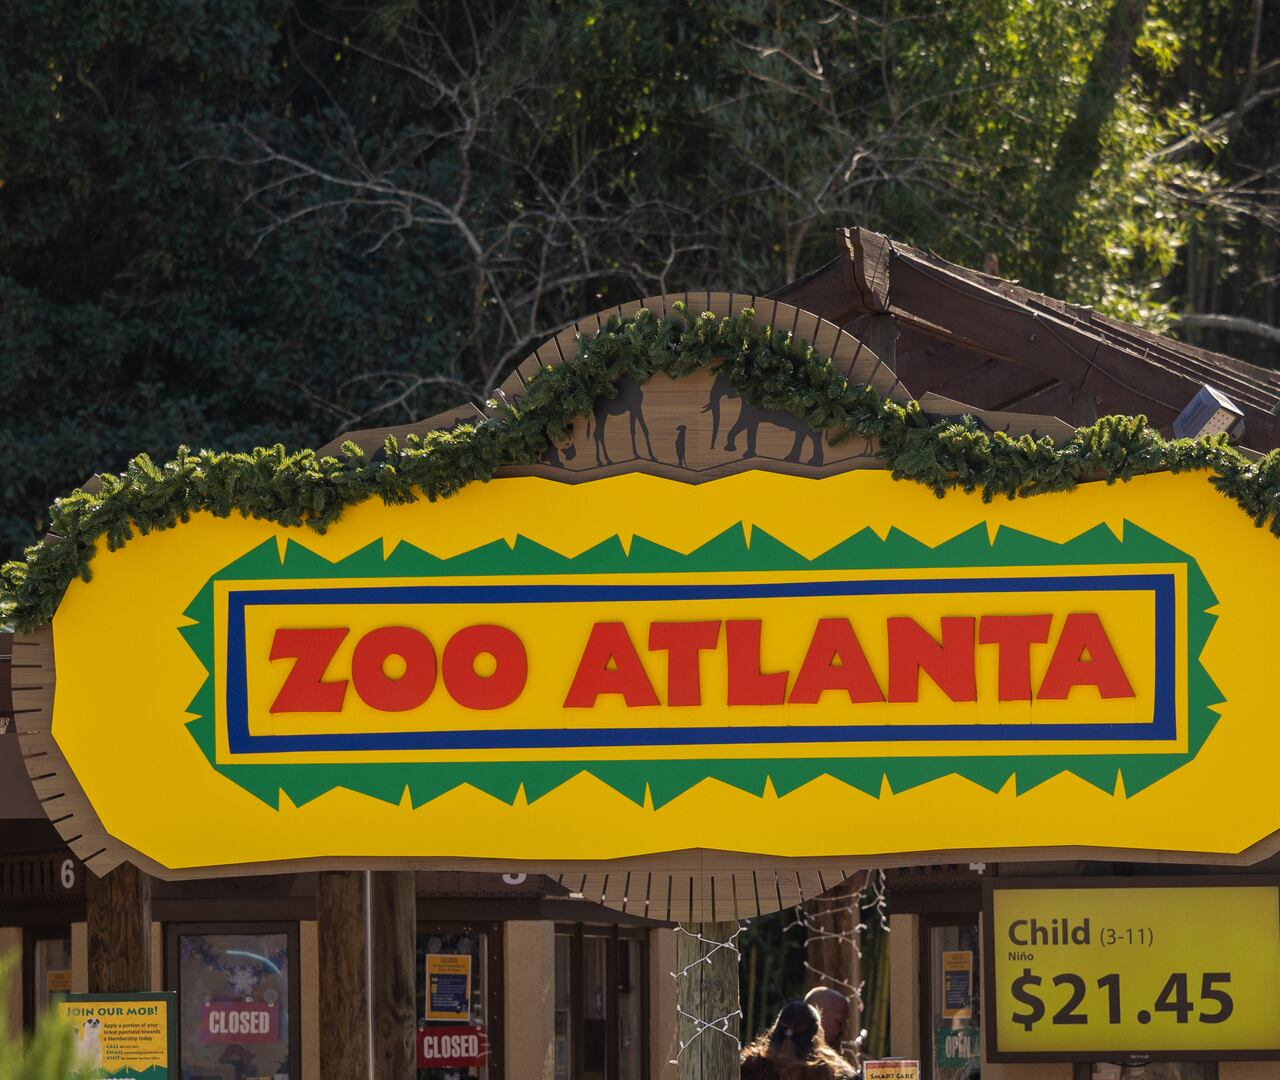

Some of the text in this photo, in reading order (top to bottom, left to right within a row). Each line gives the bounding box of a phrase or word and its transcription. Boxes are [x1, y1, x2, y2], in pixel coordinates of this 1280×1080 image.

[268, 611, 1136, 713] ZOO ATLANTA
[60, 859, 75, 888] 6
[1008, 918, 1154, 947] Child (3-11)
[1008, 951, 1034, 961] Niño
[98, 1008, 123, 1016] OUR
[126, 1006, 158, 1016] MOB!
[1011, 968, 1234, 1032] $21.45
[209, 1011, 270, 1034] CLOSED
[424, 1035, 478, 1058] CLOSED
[946, 1036, 971, 1058] OPEN
